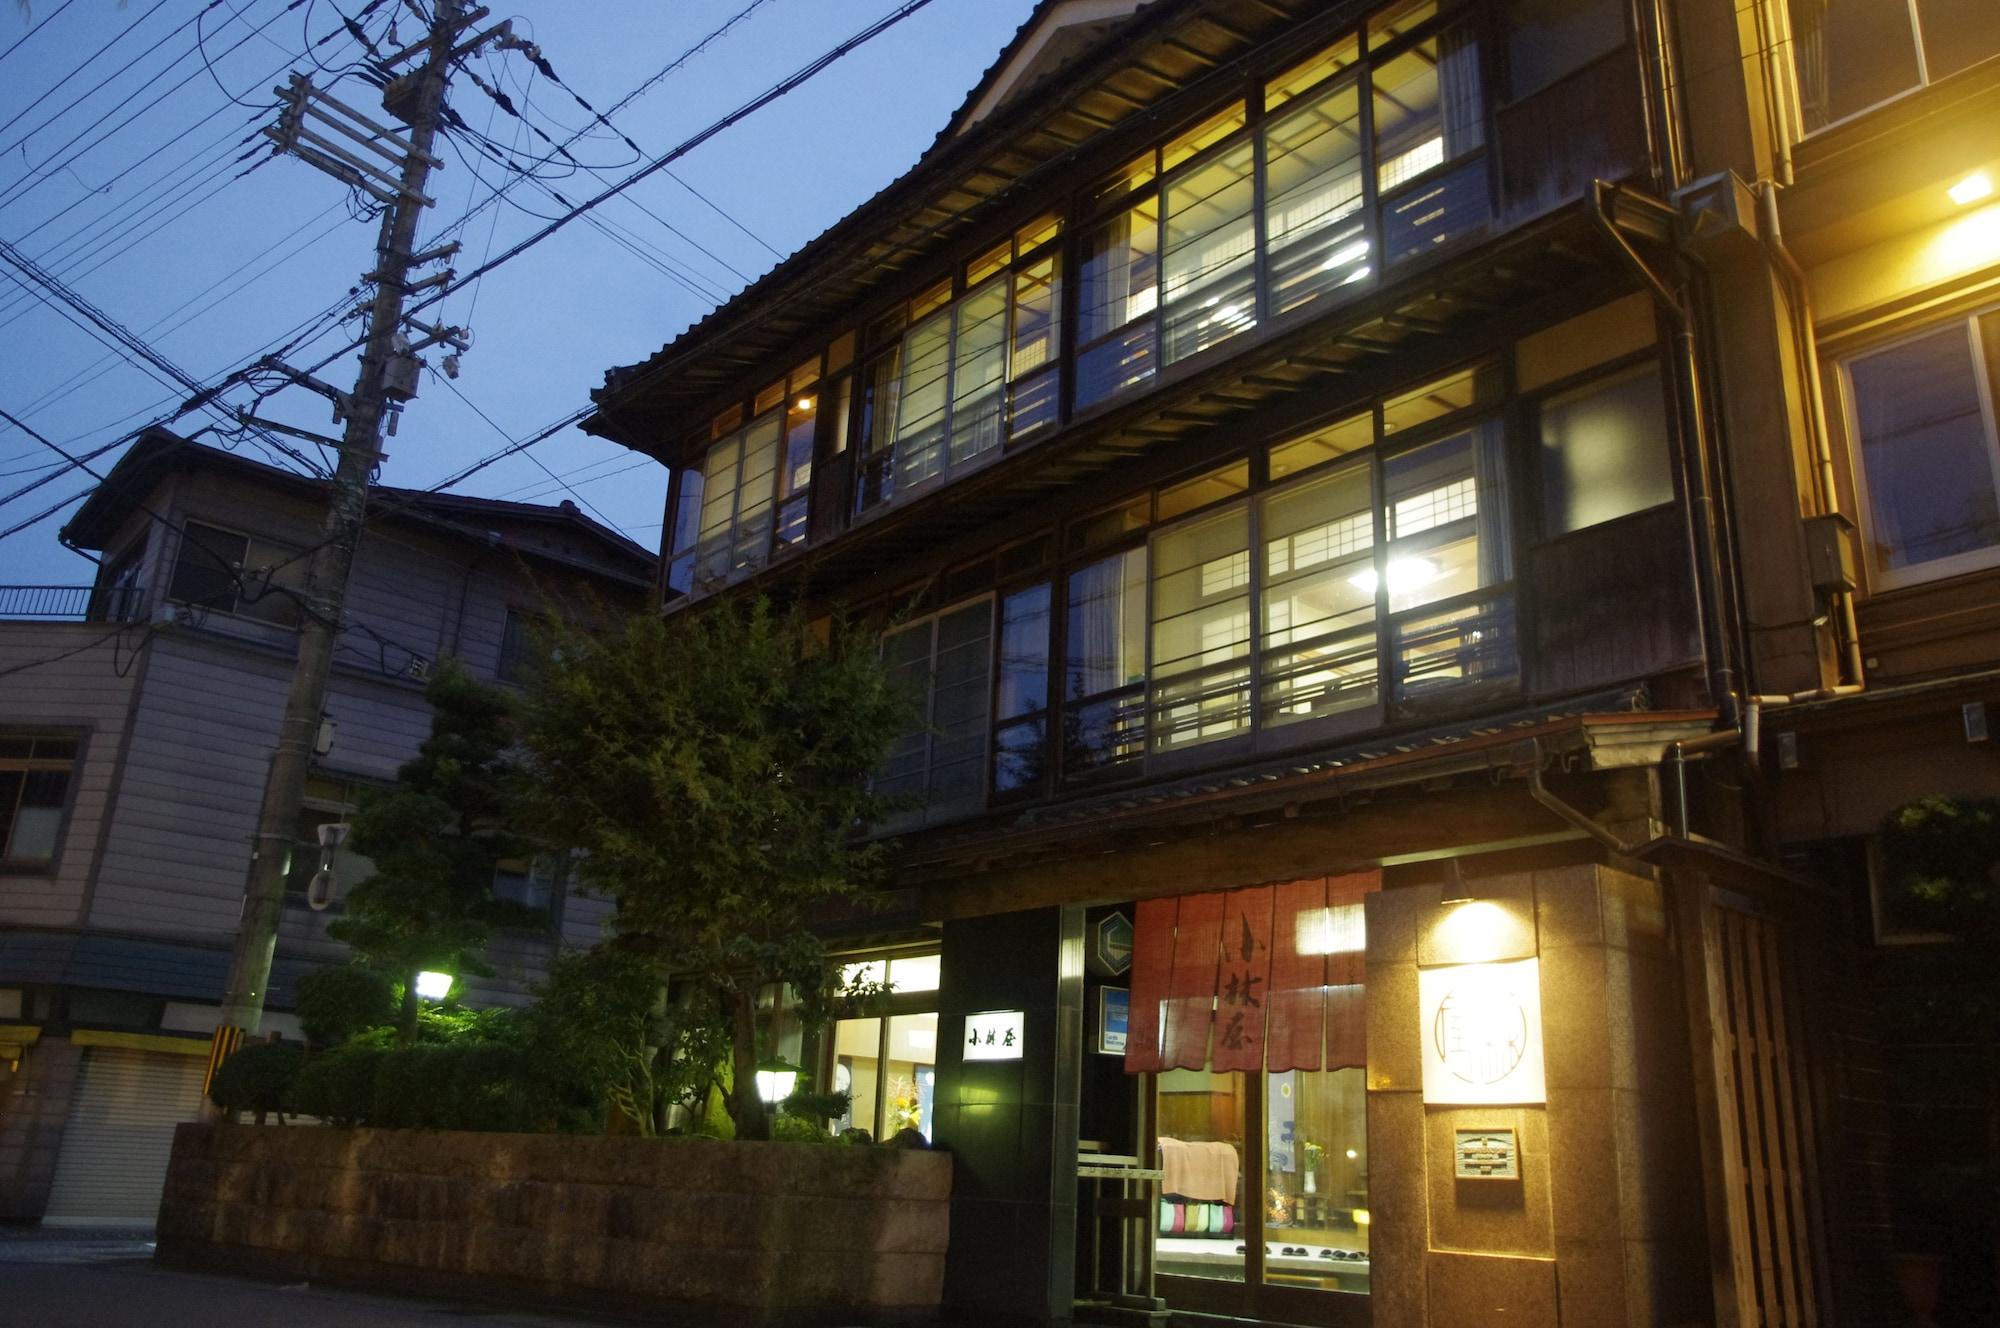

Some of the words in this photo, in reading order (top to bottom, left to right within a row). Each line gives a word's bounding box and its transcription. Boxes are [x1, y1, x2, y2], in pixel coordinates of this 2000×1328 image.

[1222, 911, 1267, 1050] 小林屋
[968, 1027, 1017, 1047] 小林屋
